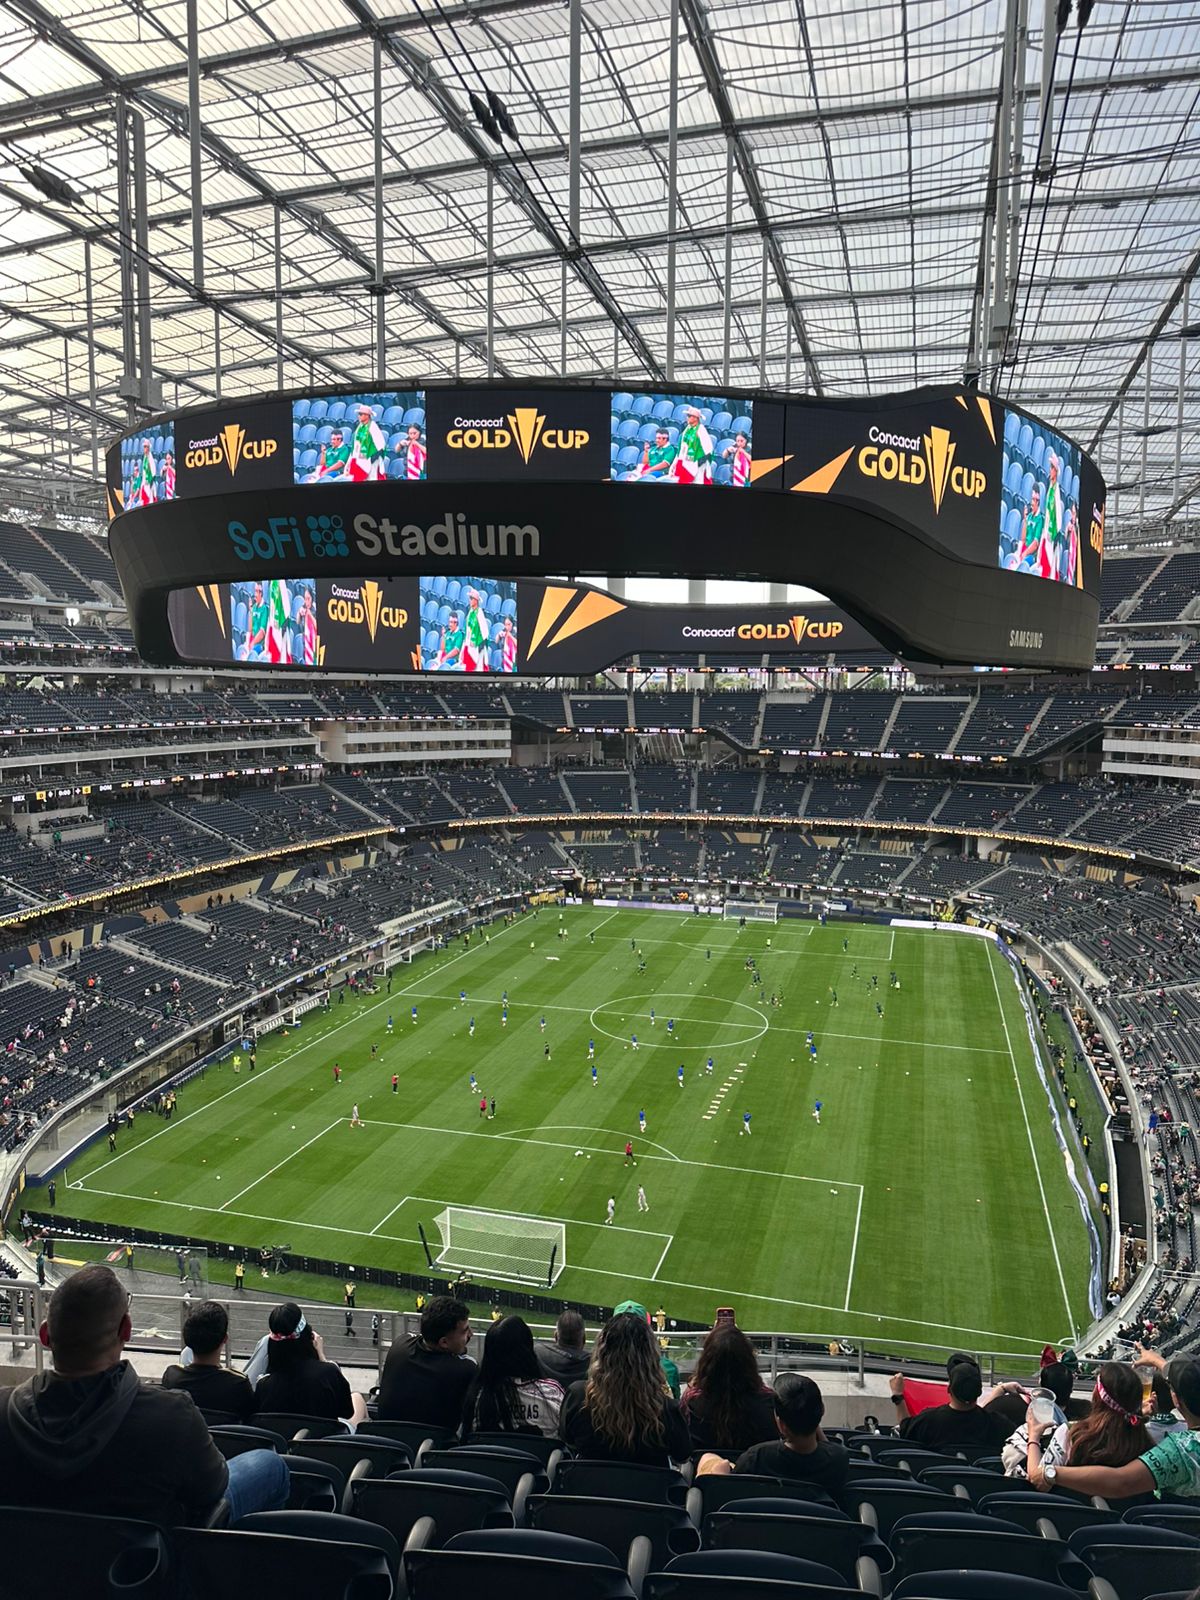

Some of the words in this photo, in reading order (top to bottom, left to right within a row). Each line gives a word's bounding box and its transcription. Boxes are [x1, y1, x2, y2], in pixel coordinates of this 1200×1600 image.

[454, 416, 504, 428] Concacaf
[188, 435, 218, 449] Concacaf
[446, 429, 511, 449] GOLD
[541, 429, 590, 449] CUP
[868, 425, 921, 450] Concacaf
[184, 446, 223, 469] GOLD
[242, 439, 278, 460] CUP
[858, 446, 926, 485] GOLD
[951, 466, 987, 498] CUP
[227, 516, 306, 561] SoFi
[353, 512, 540, 557] Stadium
[331, 583, 360, 600] Concacaf
[327, 598, 364, 624] GOLD
[380, 606, 408, 628] CUP
[682, 626, 736, 638] Concacaf
[737, 623, 790, 640] GOLD
[807, 621, 843, 638] CUP
[1009, 630, 1044, 649] SAMSUNG
